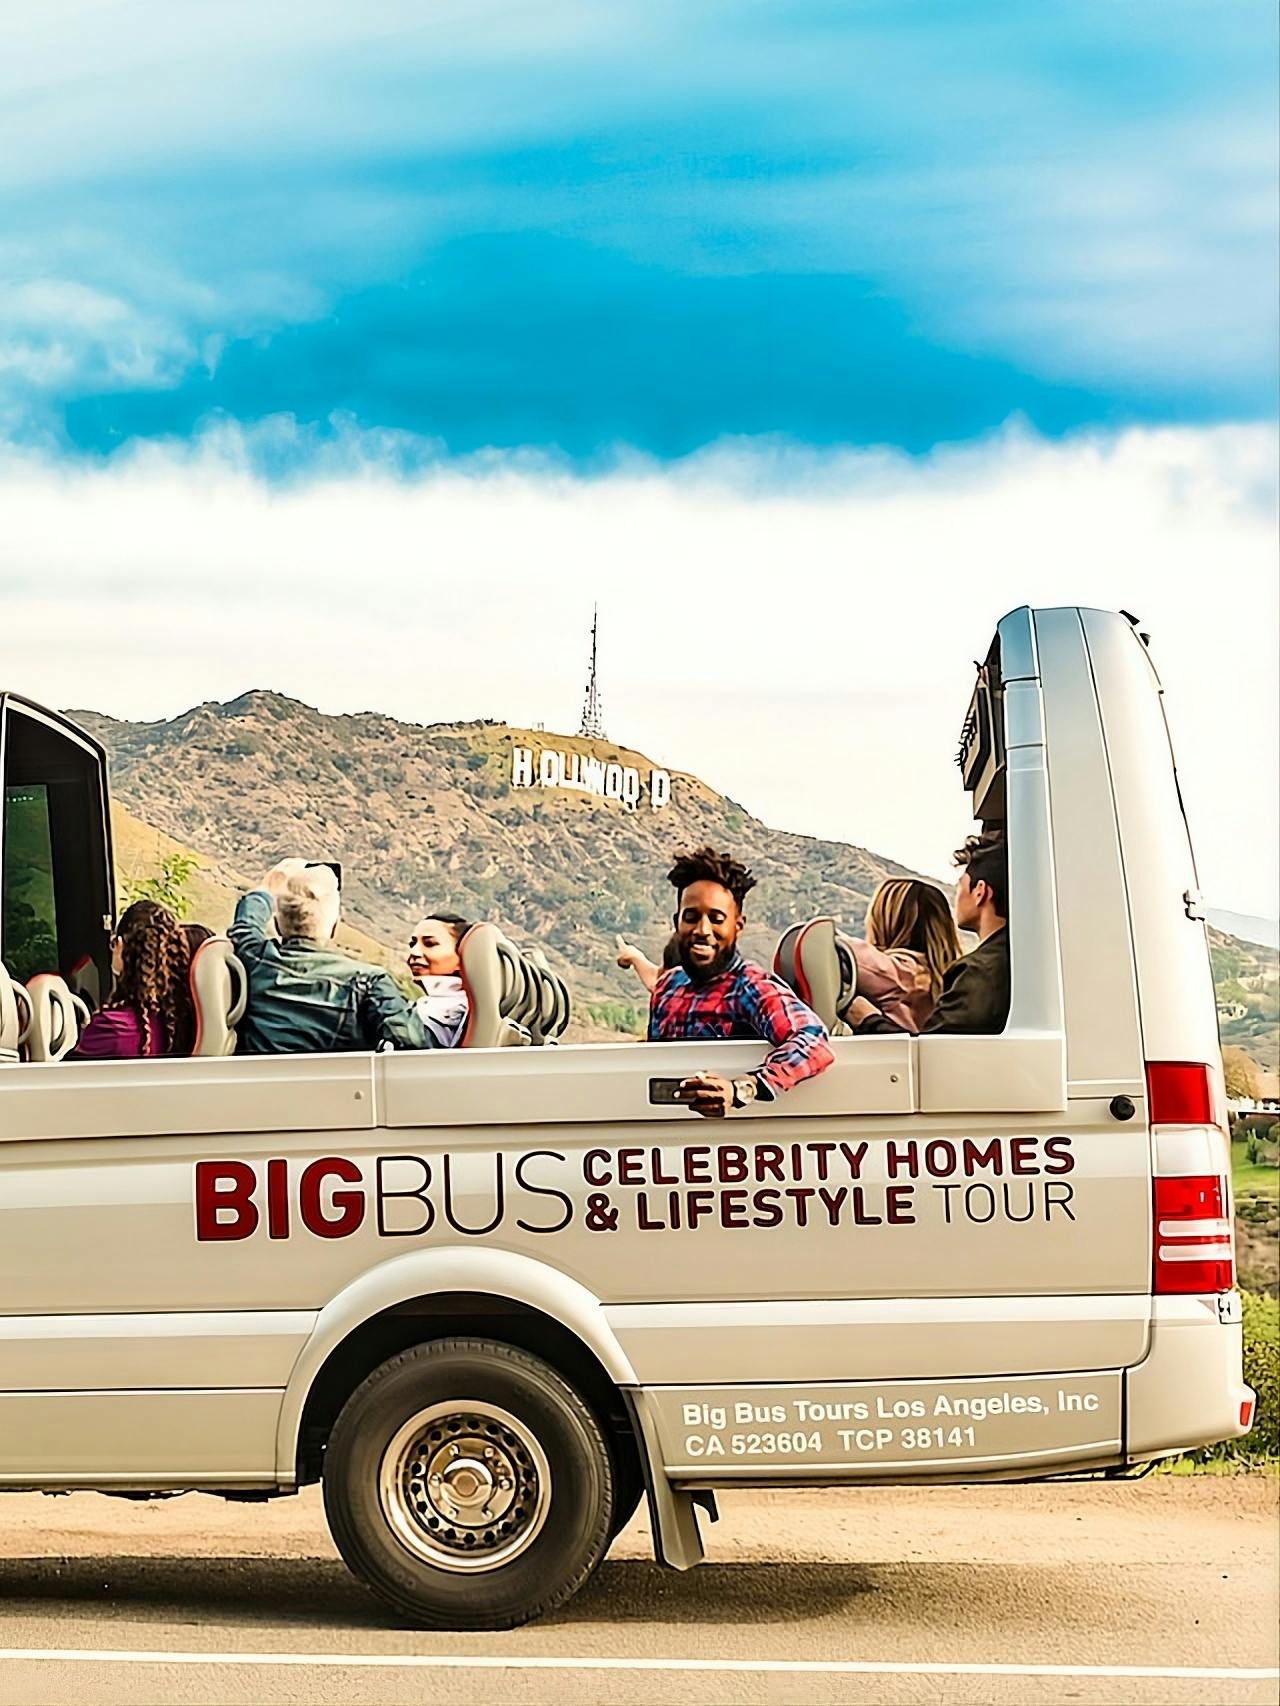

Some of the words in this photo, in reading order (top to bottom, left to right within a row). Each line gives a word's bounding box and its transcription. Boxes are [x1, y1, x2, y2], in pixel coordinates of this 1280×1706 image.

[582, 1141, 868, 1187] CELEBRITY
[886, 1136, 1076, 1179] HOMES
[584, 1192, 619, 1232] &
[637, 1184, 917, 1230] LIFESTYLE
[932, 1181, 1077, 1224] TOUR
[683, 1403, 726, 1428] Big
[734, 1402, 787, 1424] Bus
[793, 1399, 869, 1421] Tours
[876, 1396, 926, 1418] Los
[933, 1393, 1049, 1420] Angeles,
[1058, 1390, 1100, 1412] Inc
[684, 1434, 725, 1457] CA
[730, 1431, 823, 1454] 523604
[837, 1429, 894, 1451] TCP
[901, 1426, 977, 1448] 38141
